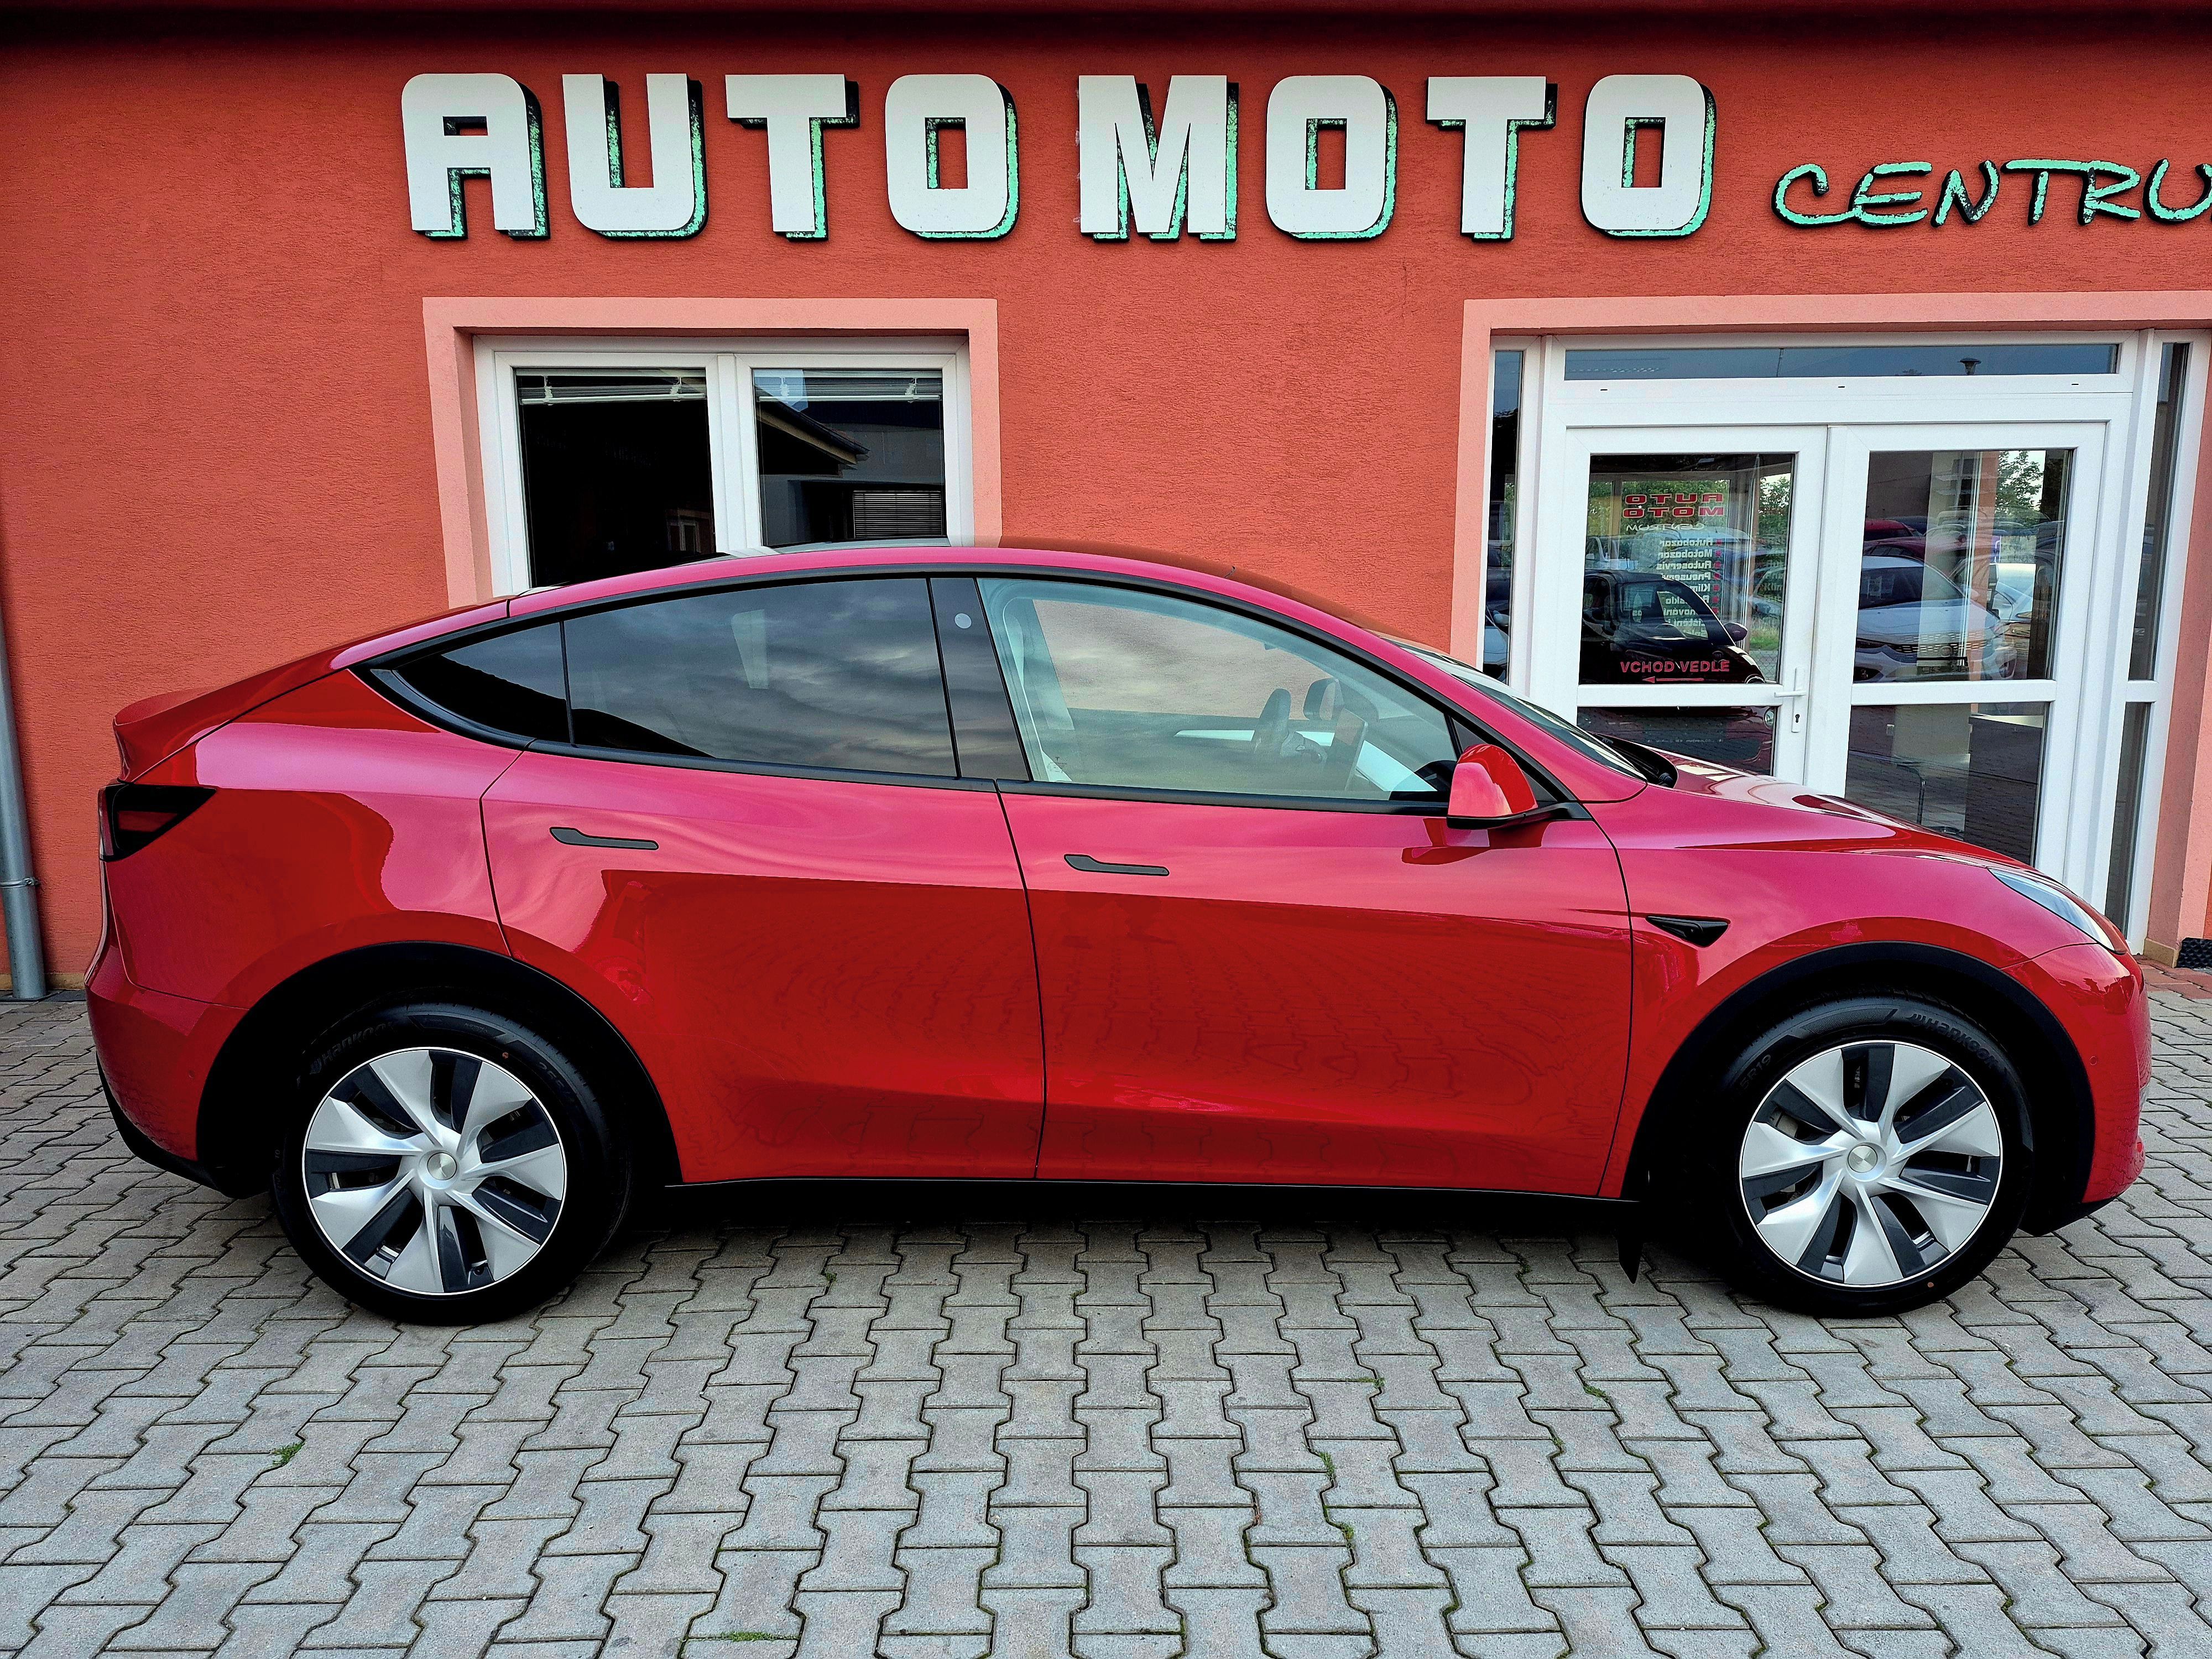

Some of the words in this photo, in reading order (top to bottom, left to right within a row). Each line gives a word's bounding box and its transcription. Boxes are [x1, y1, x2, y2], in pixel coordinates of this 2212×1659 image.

[401, 73, 1019, 241] AUTO
[1078, 74, 1717, 241] MOTO
[1771, 158, 2212, 228] CENTRU
[1620, 661, 1674, 672] VCHOD
[1679, 660, 1730, 672] VEDLE
